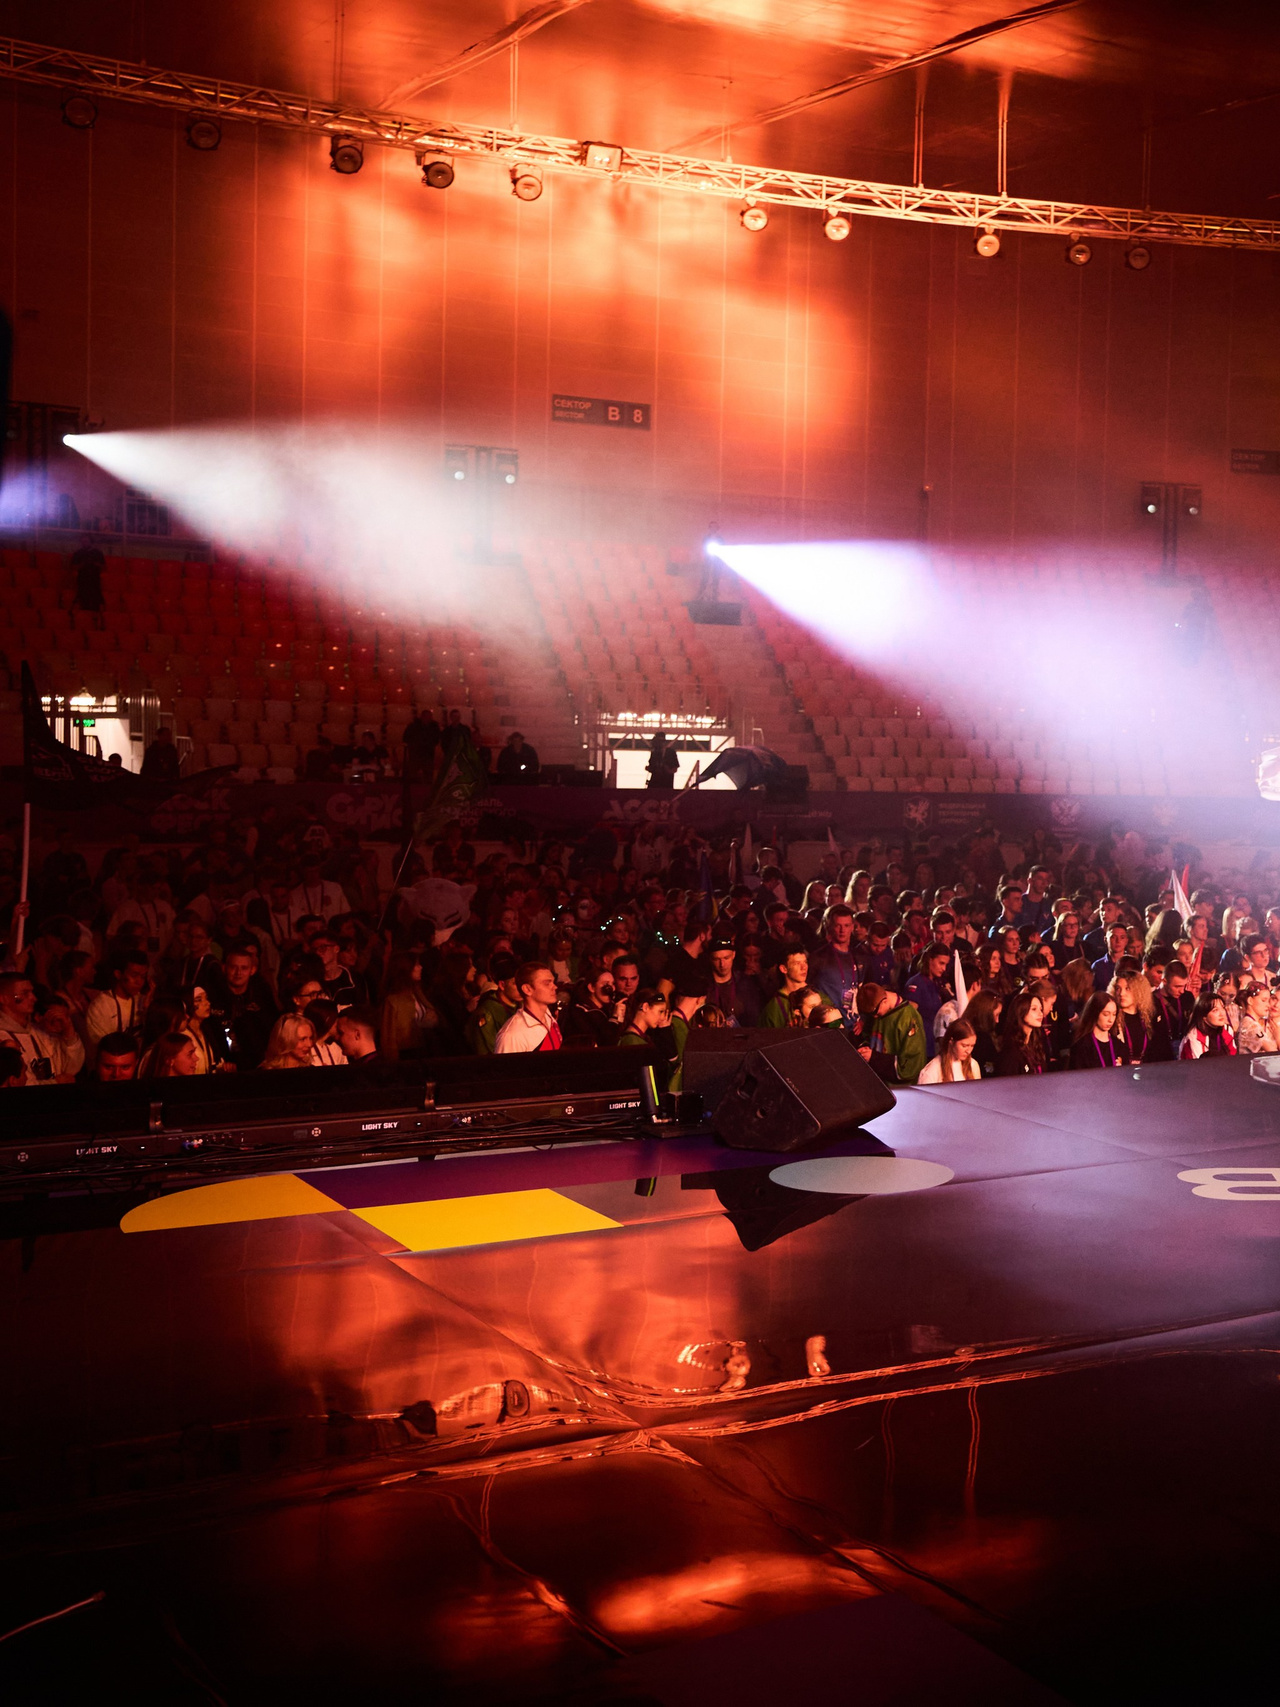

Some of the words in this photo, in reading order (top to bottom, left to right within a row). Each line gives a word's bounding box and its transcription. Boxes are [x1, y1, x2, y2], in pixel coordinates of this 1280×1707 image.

[554, 399, 592, 409] СЕКТОР
[633, 409, 643, 423] 8
[383, 1121, 399, 1129] SKY
[101, 1145, 119, 1153] SKY
